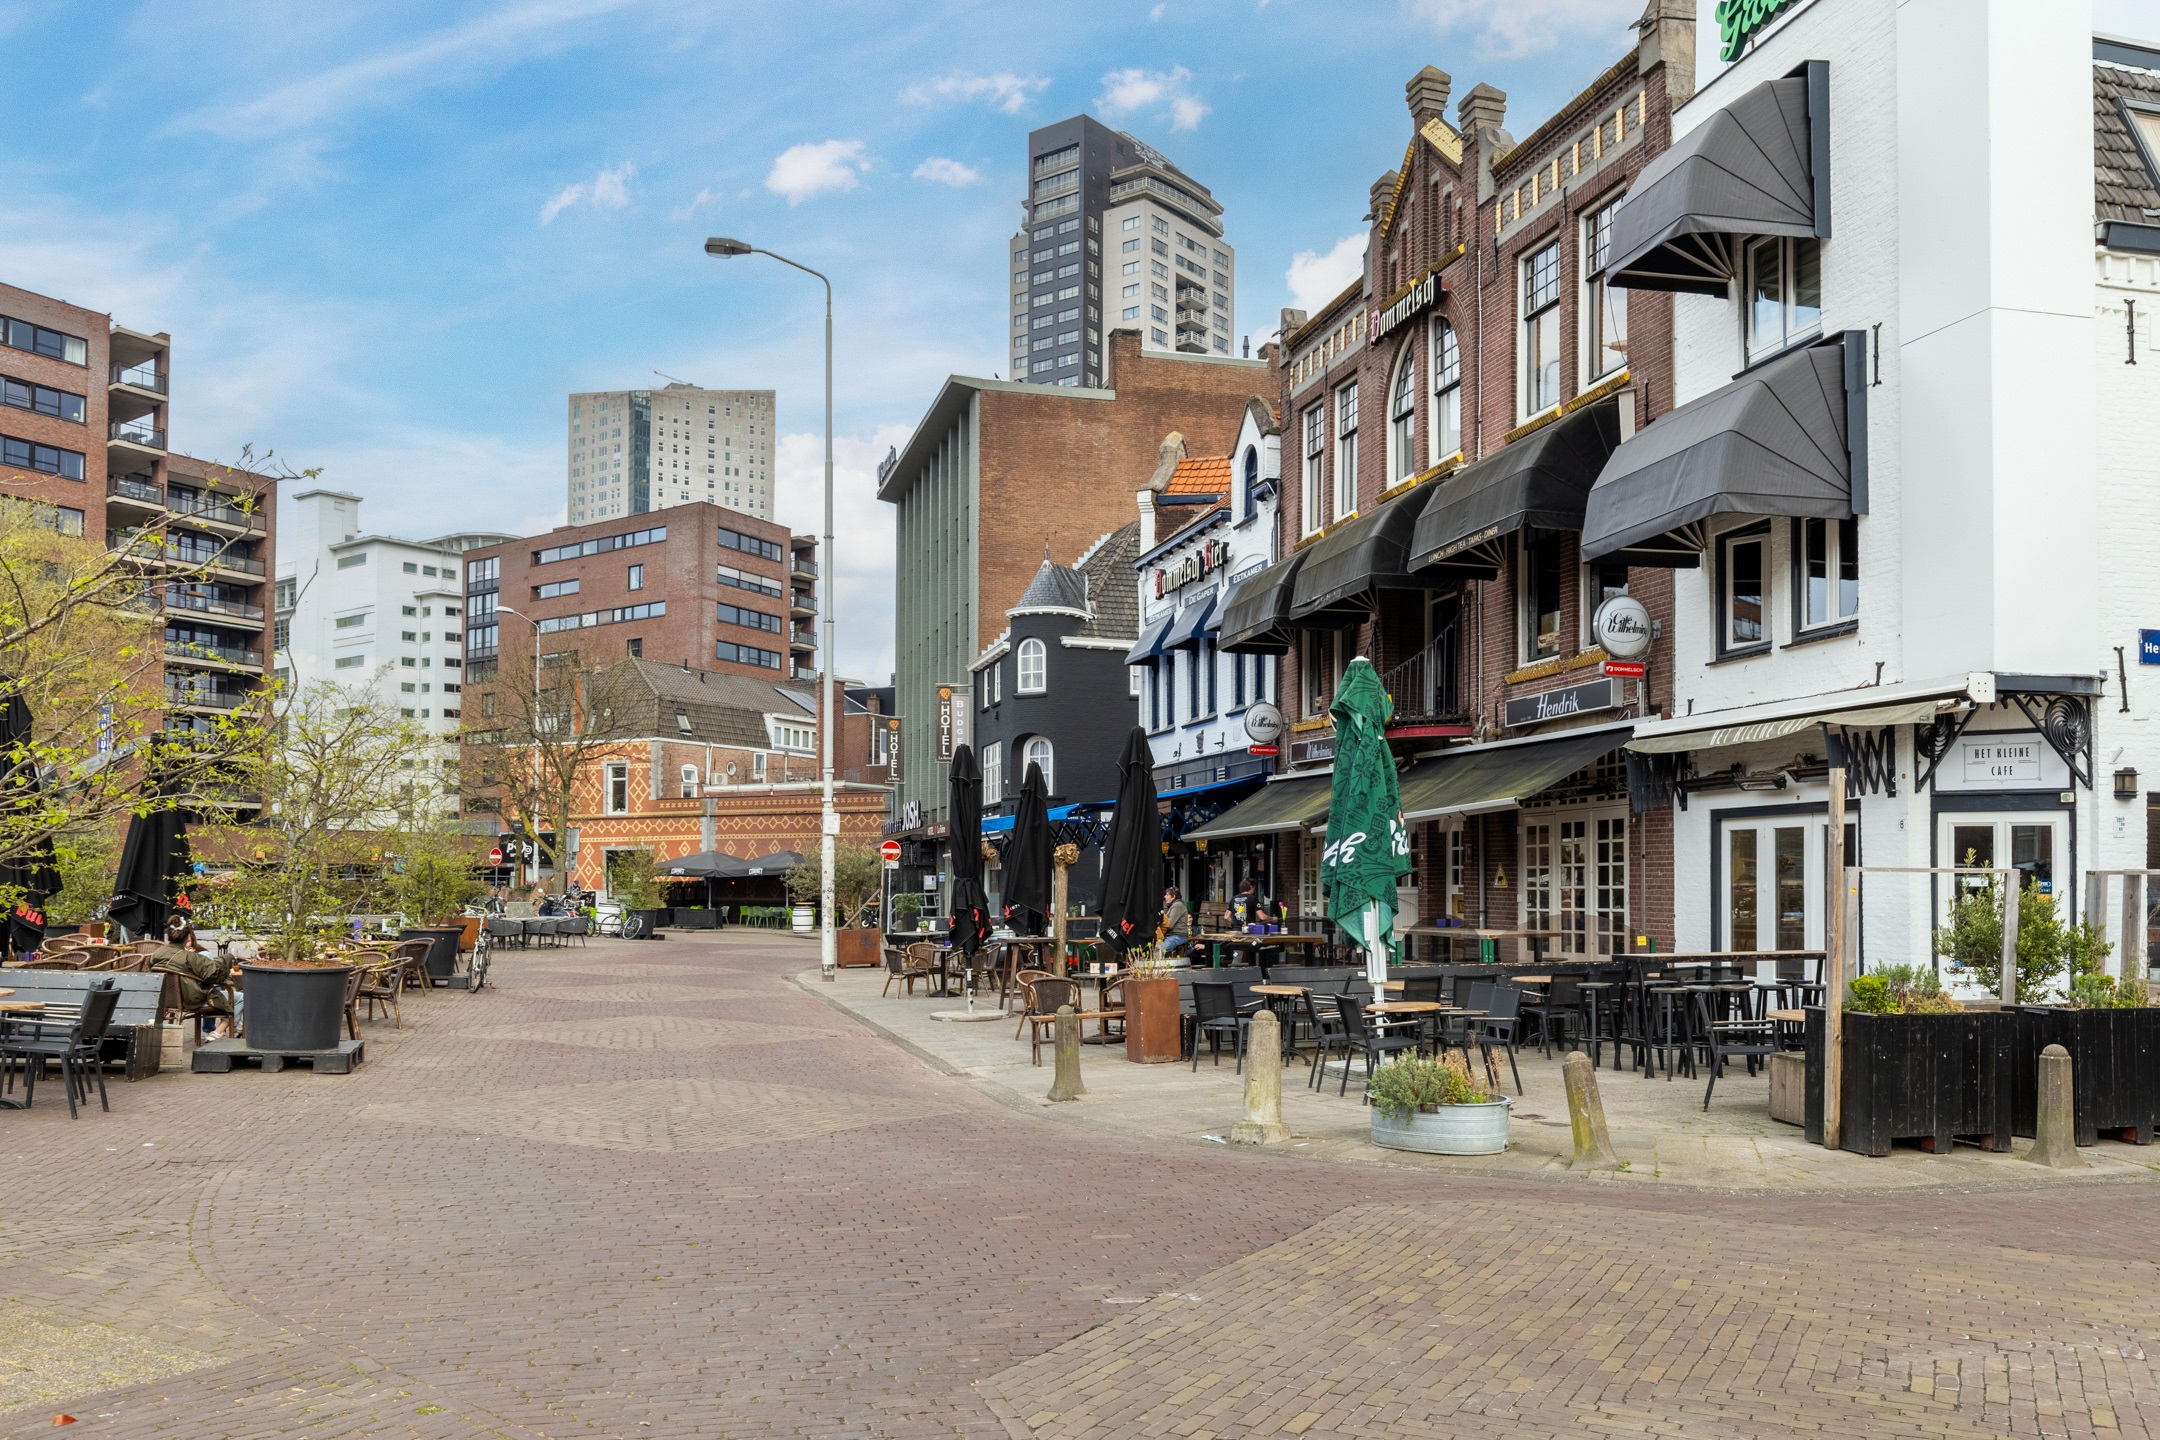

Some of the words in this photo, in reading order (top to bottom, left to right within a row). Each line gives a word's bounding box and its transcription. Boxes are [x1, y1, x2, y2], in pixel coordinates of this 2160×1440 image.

[1370, 271, 1434, 344] Dommelsch
[1155, 555, 1200, 600] Dommelsch
[1204, 539, 1224, 575] Bier
[1537, 691, 1580, 719] Hendrik
[941, 705, 950, 755] HOTEL
[956, 701, 964, 745] BUDGE
[890, 735, 898, 776] HOTEL
[1974, 748, 1991, 759] HET
[1996, 747, 2029, 758] KLEINE
[1991, 766, 2013, 776] CAFE
[1900, 820, 1904, 829] 8
[1418, 877, 1423, 890] 6
